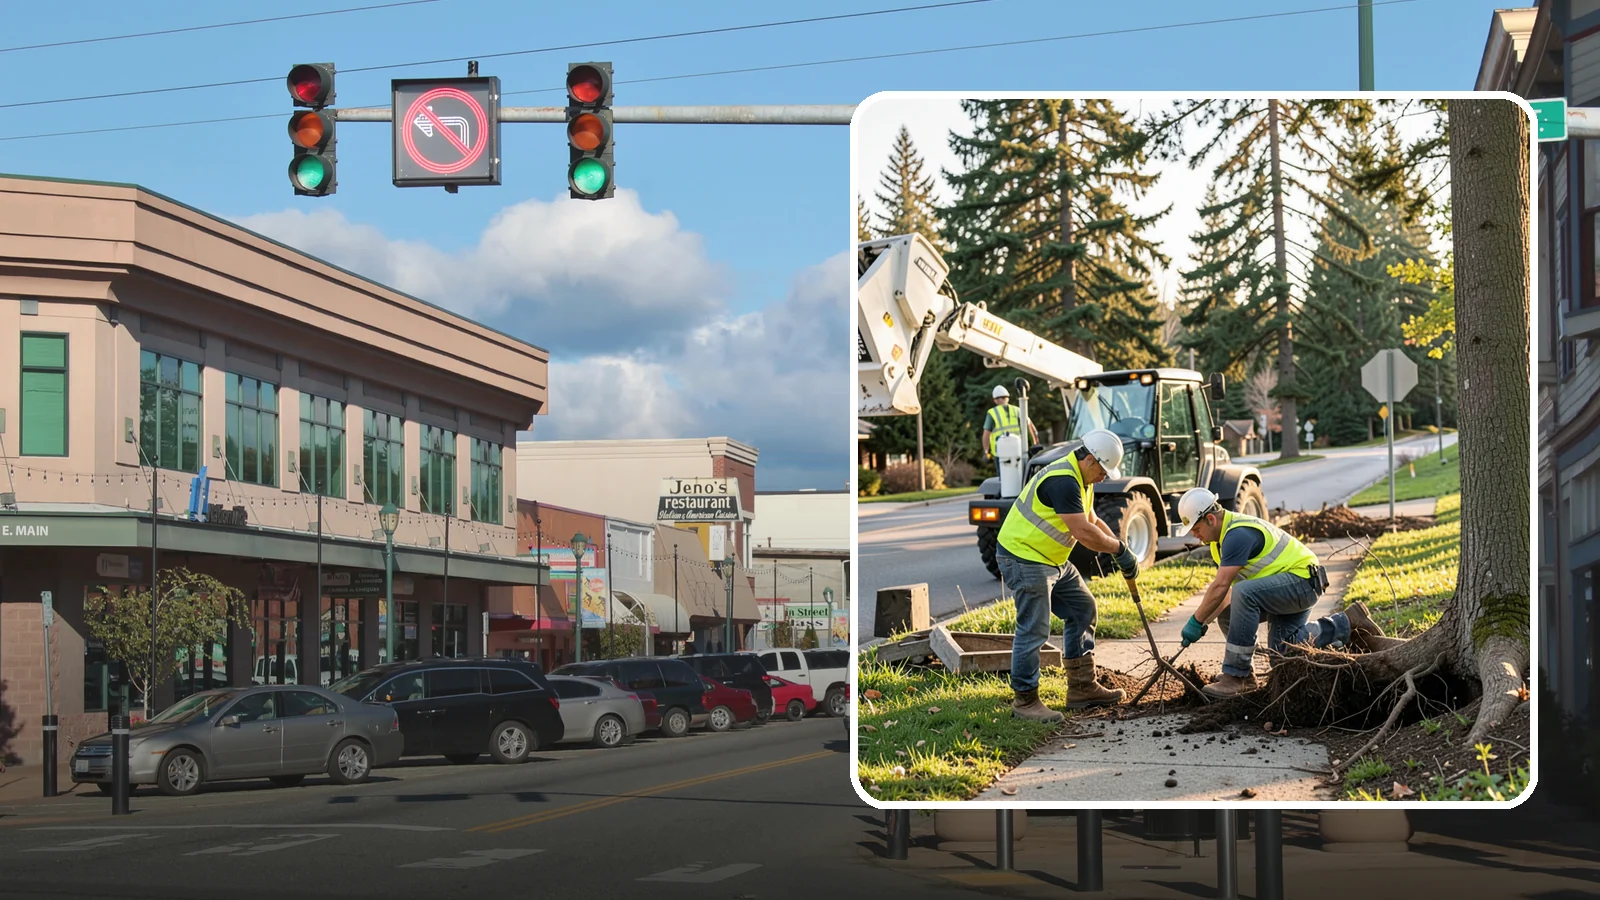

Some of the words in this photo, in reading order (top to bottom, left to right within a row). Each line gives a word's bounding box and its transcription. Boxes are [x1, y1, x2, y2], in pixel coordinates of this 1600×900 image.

[669, 480, 727, 494] Jeno's
[665, 497, 731, 509] restaurant
[659, 510, 681, 519] Italian
[686, 510, 714, 519] American
[715, 510, 737, 519] Cuisine
[2, 525, 13, 536] E.
[15, 525, 49, 536] MAIN
[797, 607, 828, 616] Street
